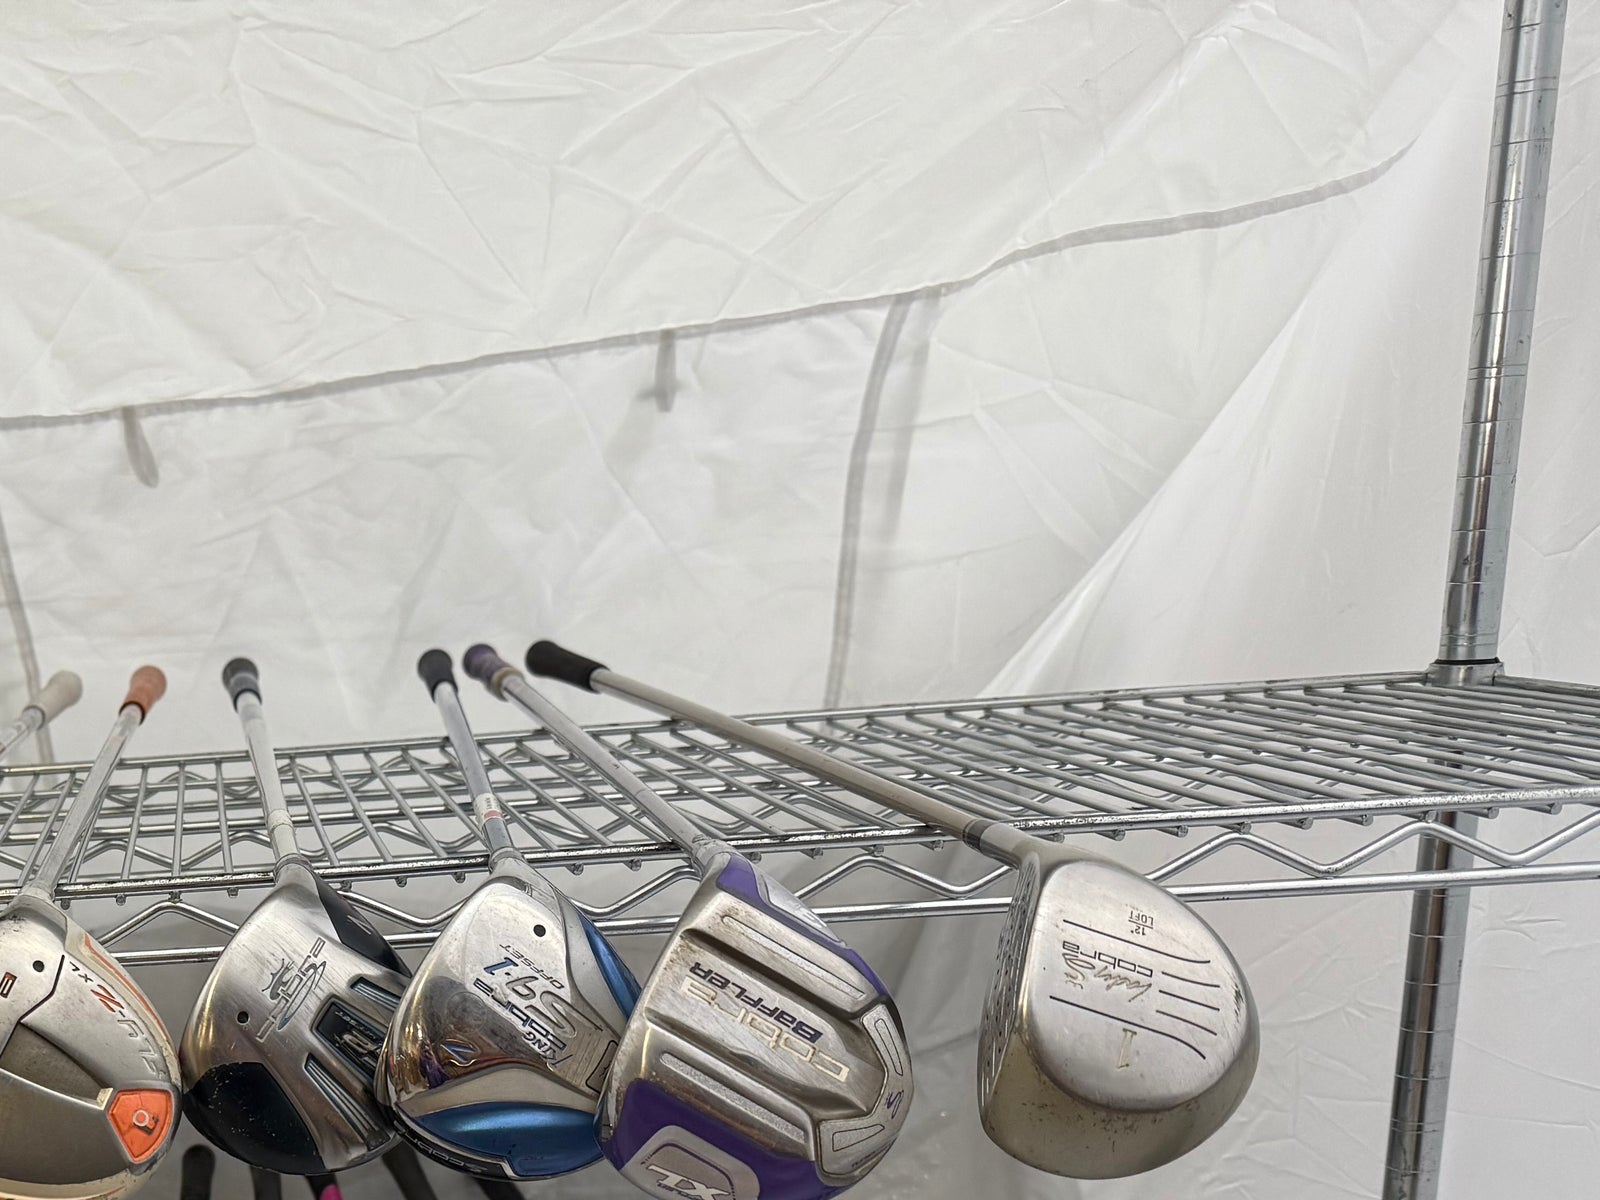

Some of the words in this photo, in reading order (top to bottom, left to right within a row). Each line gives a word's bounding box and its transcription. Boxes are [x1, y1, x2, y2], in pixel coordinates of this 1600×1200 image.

[1128, 910, 1154, 926] LOFT
[69, 960, 95, 984] XL
[499, 944, 565, 990] OFFSET
[1062, 940, 1154, 978] cobra
[255, 936, 327, 1043] cobra
[1093, 965, 1153, 1003] Lady
[473, 977, 568, 1051] cobra
[680, 974, 850, 1083] cobra
[522, 1031, 574, 1069] KING
[1116, 1028, 1138, 1070] 1
